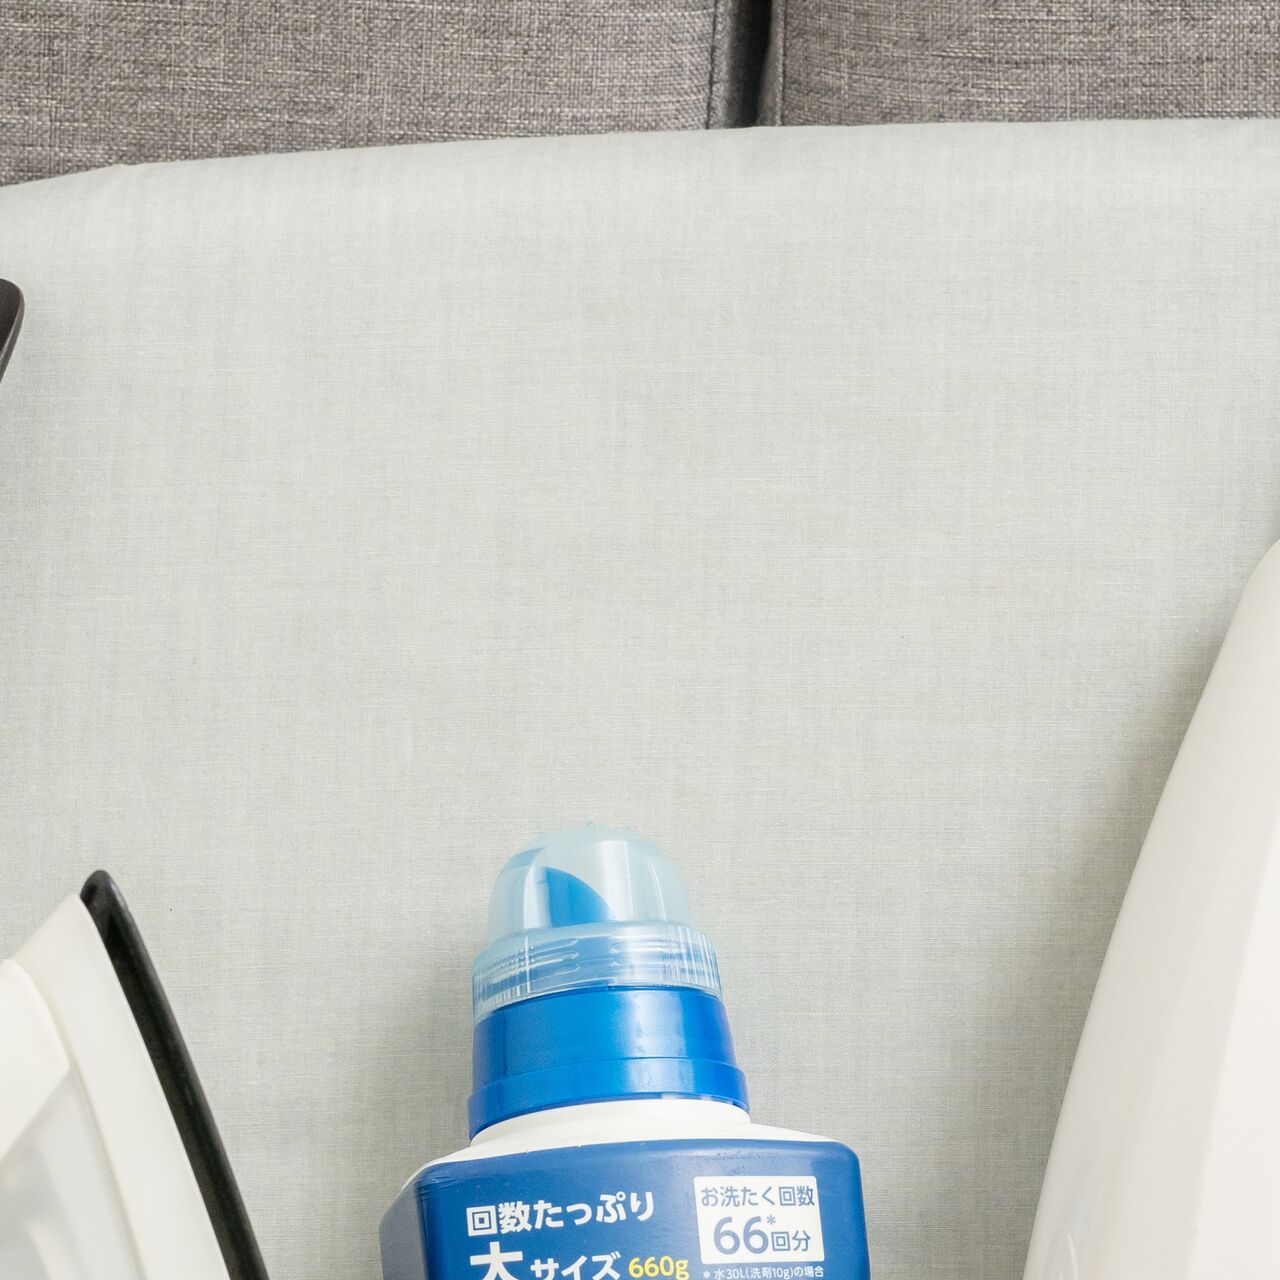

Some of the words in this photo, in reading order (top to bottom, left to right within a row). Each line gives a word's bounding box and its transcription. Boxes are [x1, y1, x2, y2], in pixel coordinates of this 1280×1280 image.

[700, 1185, 816, 1207] お洗たく回数
[466, 1191, 654, 1237] 回数たっぷり
[628, 1255, 690, 1280] 660g
